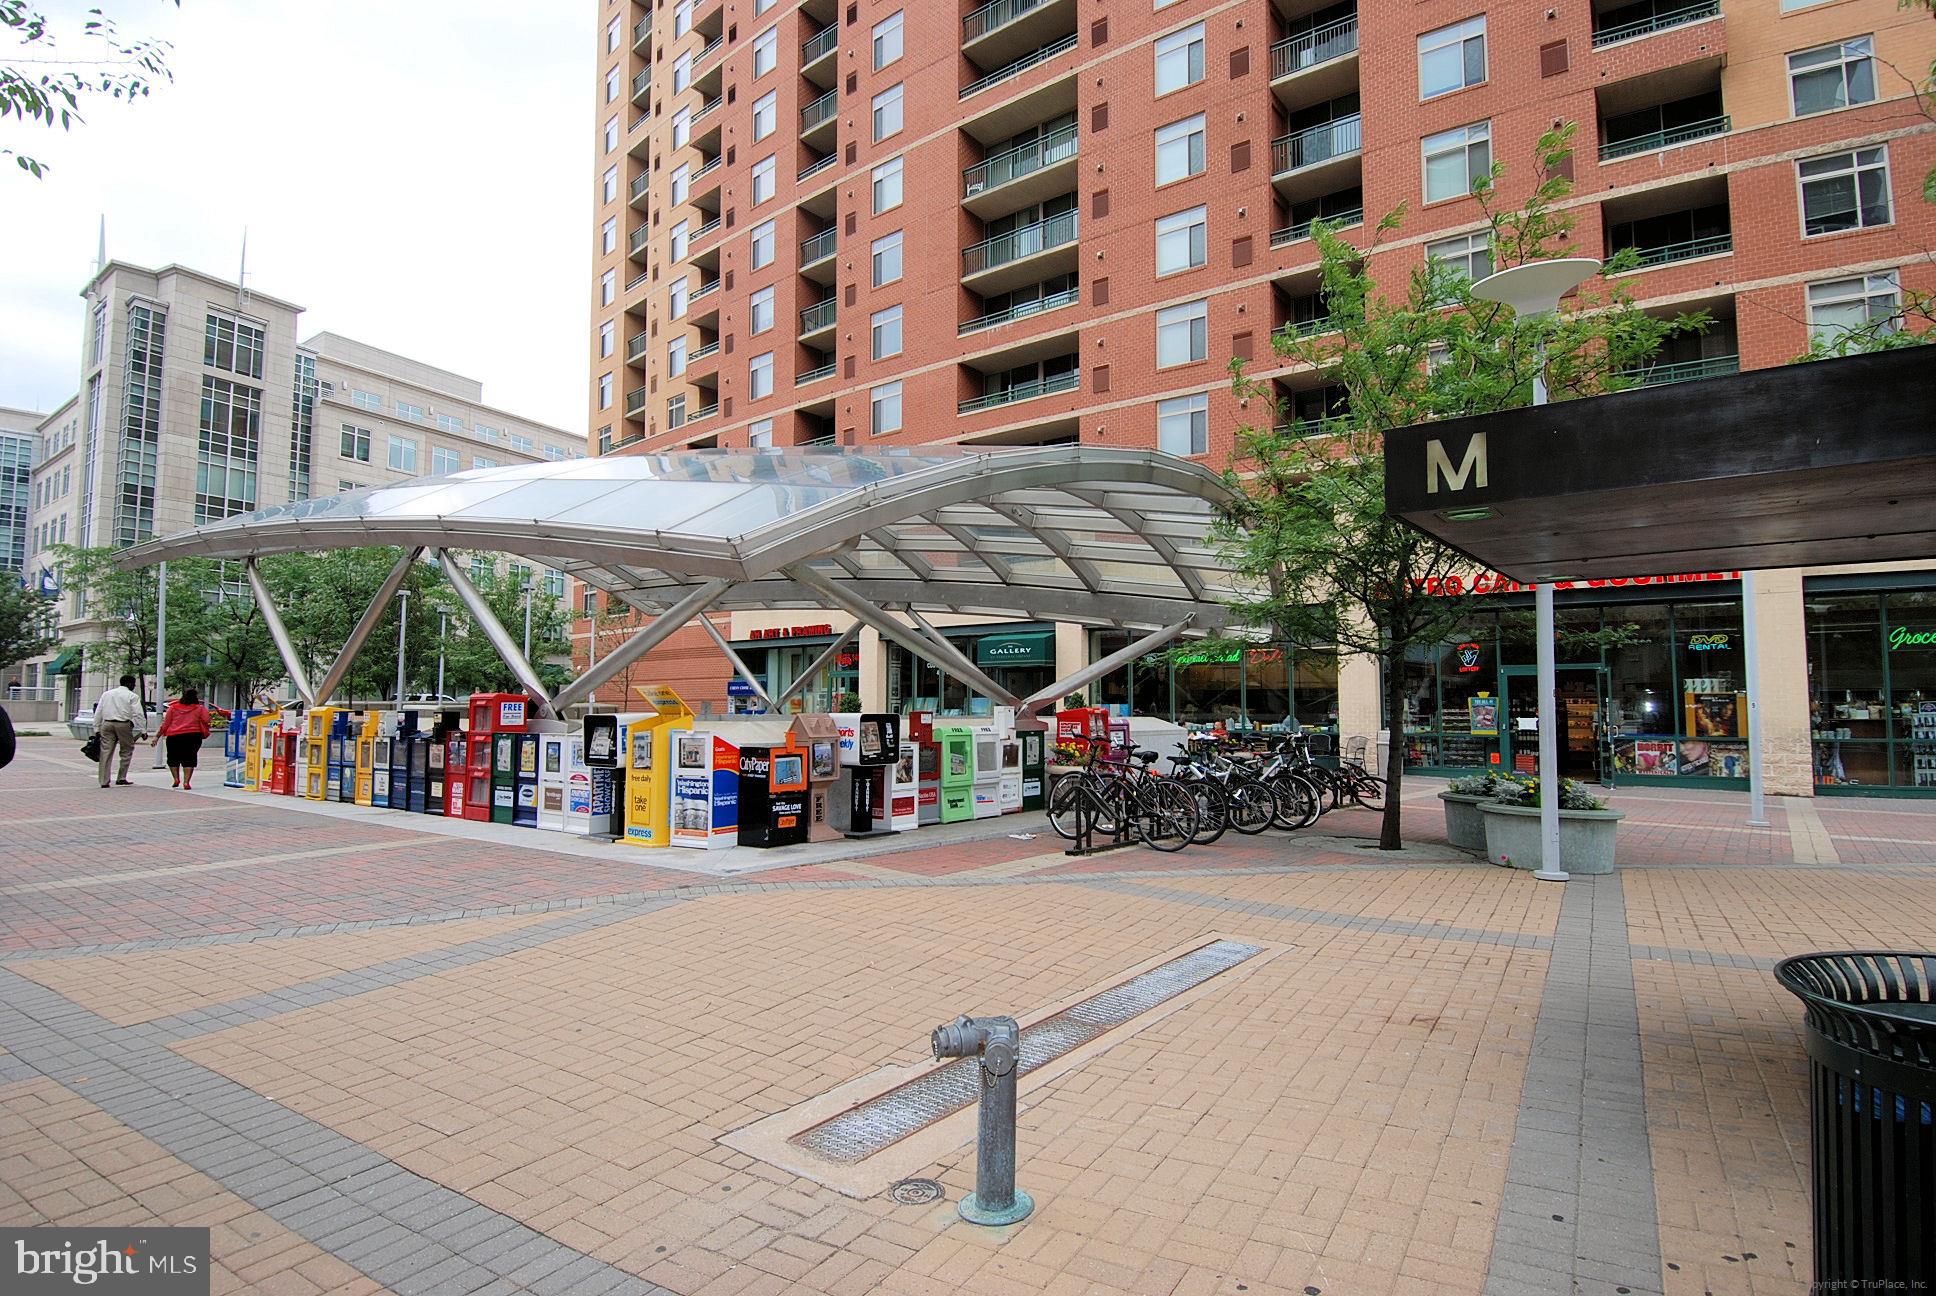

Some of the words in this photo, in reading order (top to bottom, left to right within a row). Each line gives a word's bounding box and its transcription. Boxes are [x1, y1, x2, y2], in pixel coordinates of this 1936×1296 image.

[1427, 431, 1488, 494] M
[1690, 634, 1729, 644] DVD
[990, 647, 1032, 655] GALLERY
[1688, 643, 1732, 651] RENTAL
[503, 703, 522, 711] FREE
[837, 728, 854, 737] orts
[641, 774, 651, 783] daily
[634, 795, 647, 805] take
[815, 795, 823, 822] FREE
[627, 827, 652, 838] express
